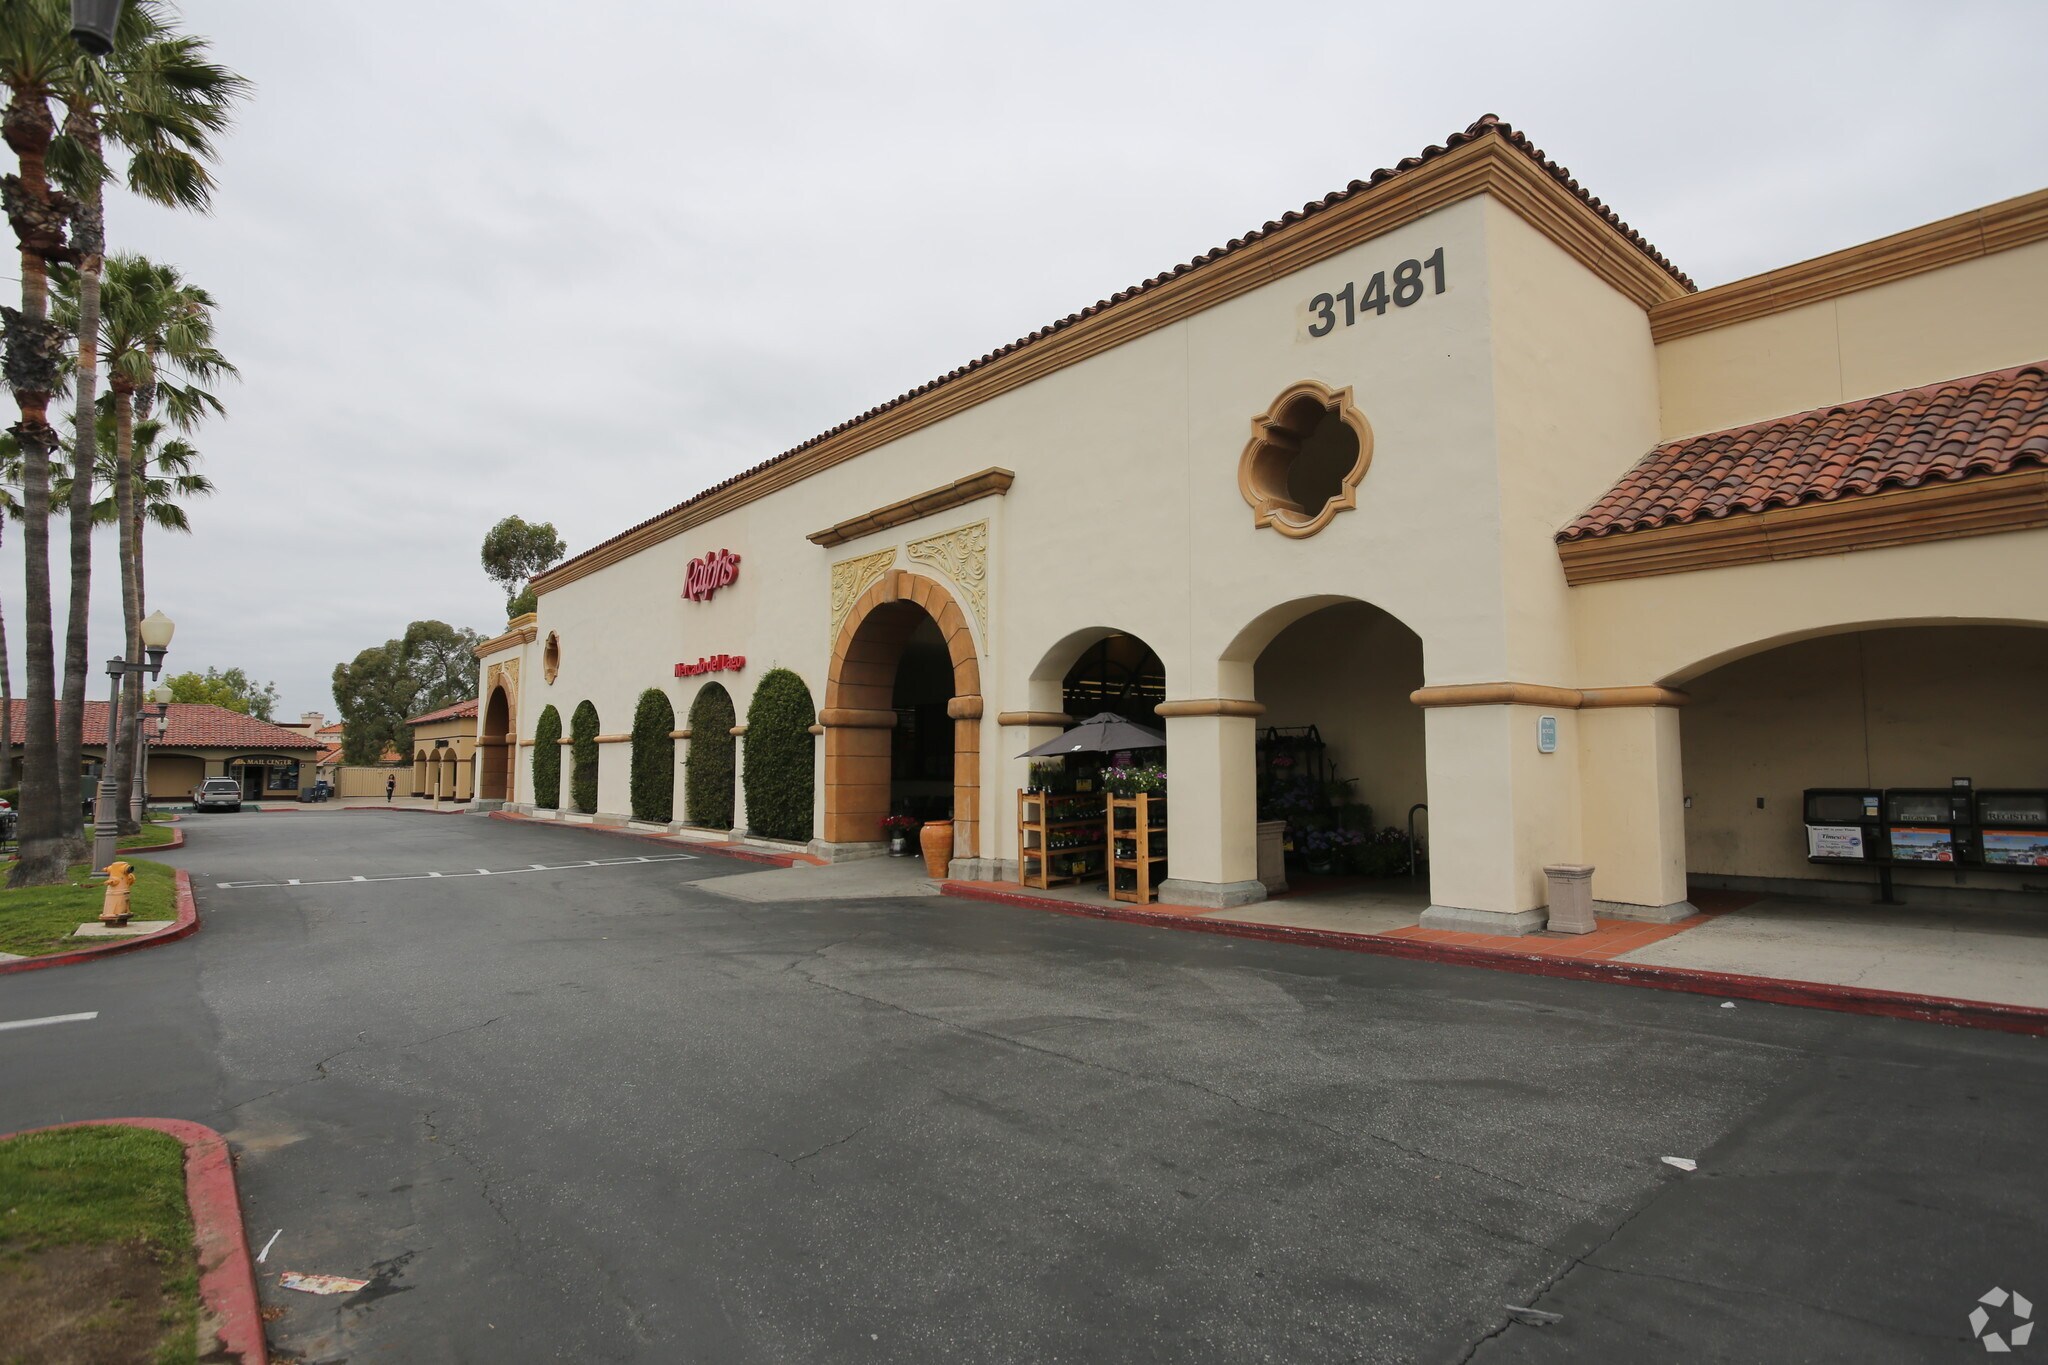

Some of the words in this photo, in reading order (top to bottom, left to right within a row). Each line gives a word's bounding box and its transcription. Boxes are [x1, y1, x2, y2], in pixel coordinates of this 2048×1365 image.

[1308, 246, 1446, 338] 31481
[681, 548, 741, 602] Ralphs
[675, 658, 706, 677] Mercado
[706, 656, 720, 671] del
[720, 654, 746, 671] Lago
[1988, 813, 2040, 821] REGISTER
